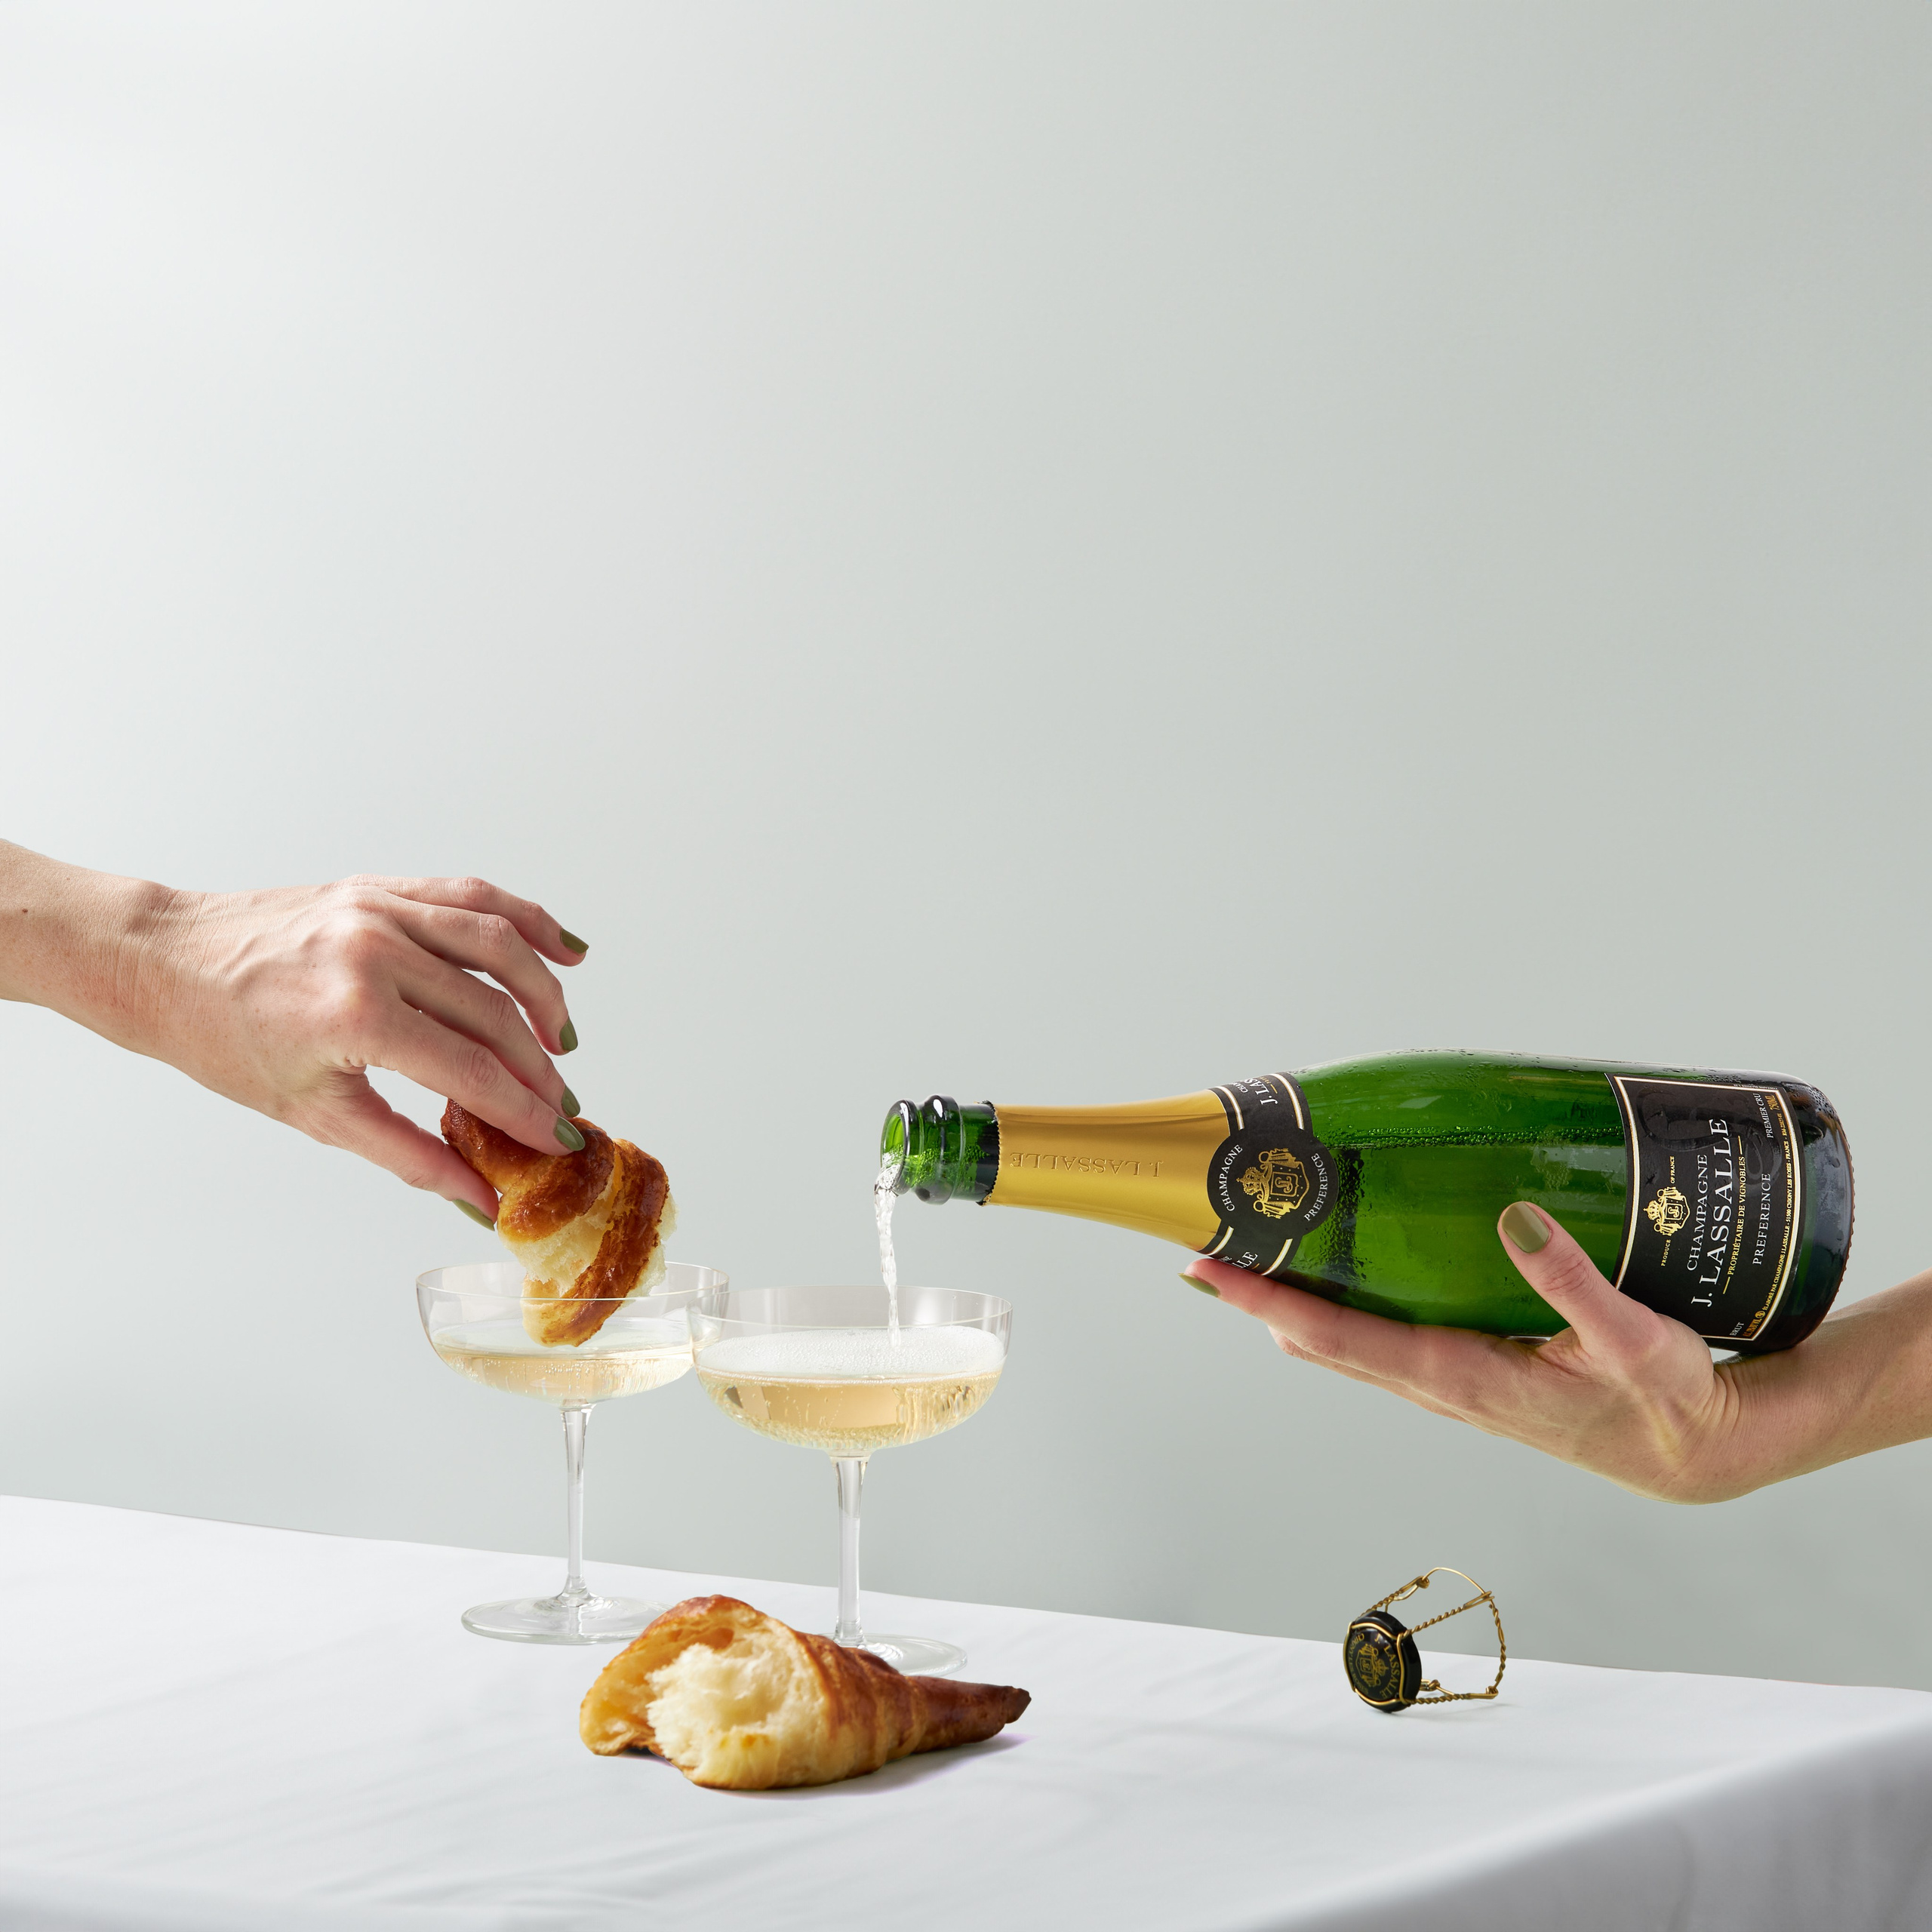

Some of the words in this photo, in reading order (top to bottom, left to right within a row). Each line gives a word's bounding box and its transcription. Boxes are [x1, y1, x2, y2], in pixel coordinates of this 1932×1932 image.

[1260, 1095, 1278, 1105] J.
[1753, 1093, 1764, 1106] CRU
[1759, 1106, 1774, 1138] PREMIER
[1009, 1152, 1142, 1177] LASSALLE
[1149, 1160, 1164, 1177] J.
[1218, 1144, 1243, 1212] CHAMPAGNE
[1669, 1174, 1676, 1184] OF
[1303, 1152, 1328, 1222] PREFERENCE
[1738, 1156, 1746, 1203] VIGNOBLES
[1687, 1154, 1708, 1271] CHAMPAGNE
[1699, 1118, 1733, 1285] LASSALLE
[1738, 1204, 1746, 1217] DE
[1752, 1174, 1771, 1265] PREFERENCE
[1661, 1238, 1672, 1267] PRODUCE
[1727, 1218, 1744, 1275] PROPRIÉTAIRE
[1773, 1254, 1786, 1283] CHAMPAGNE
[1690, 1292, 1713, 1307] J.
[1729, 1321, 1744, 1336] BRUT
[1379, 1643, 1401, 1700] LASSALLE
